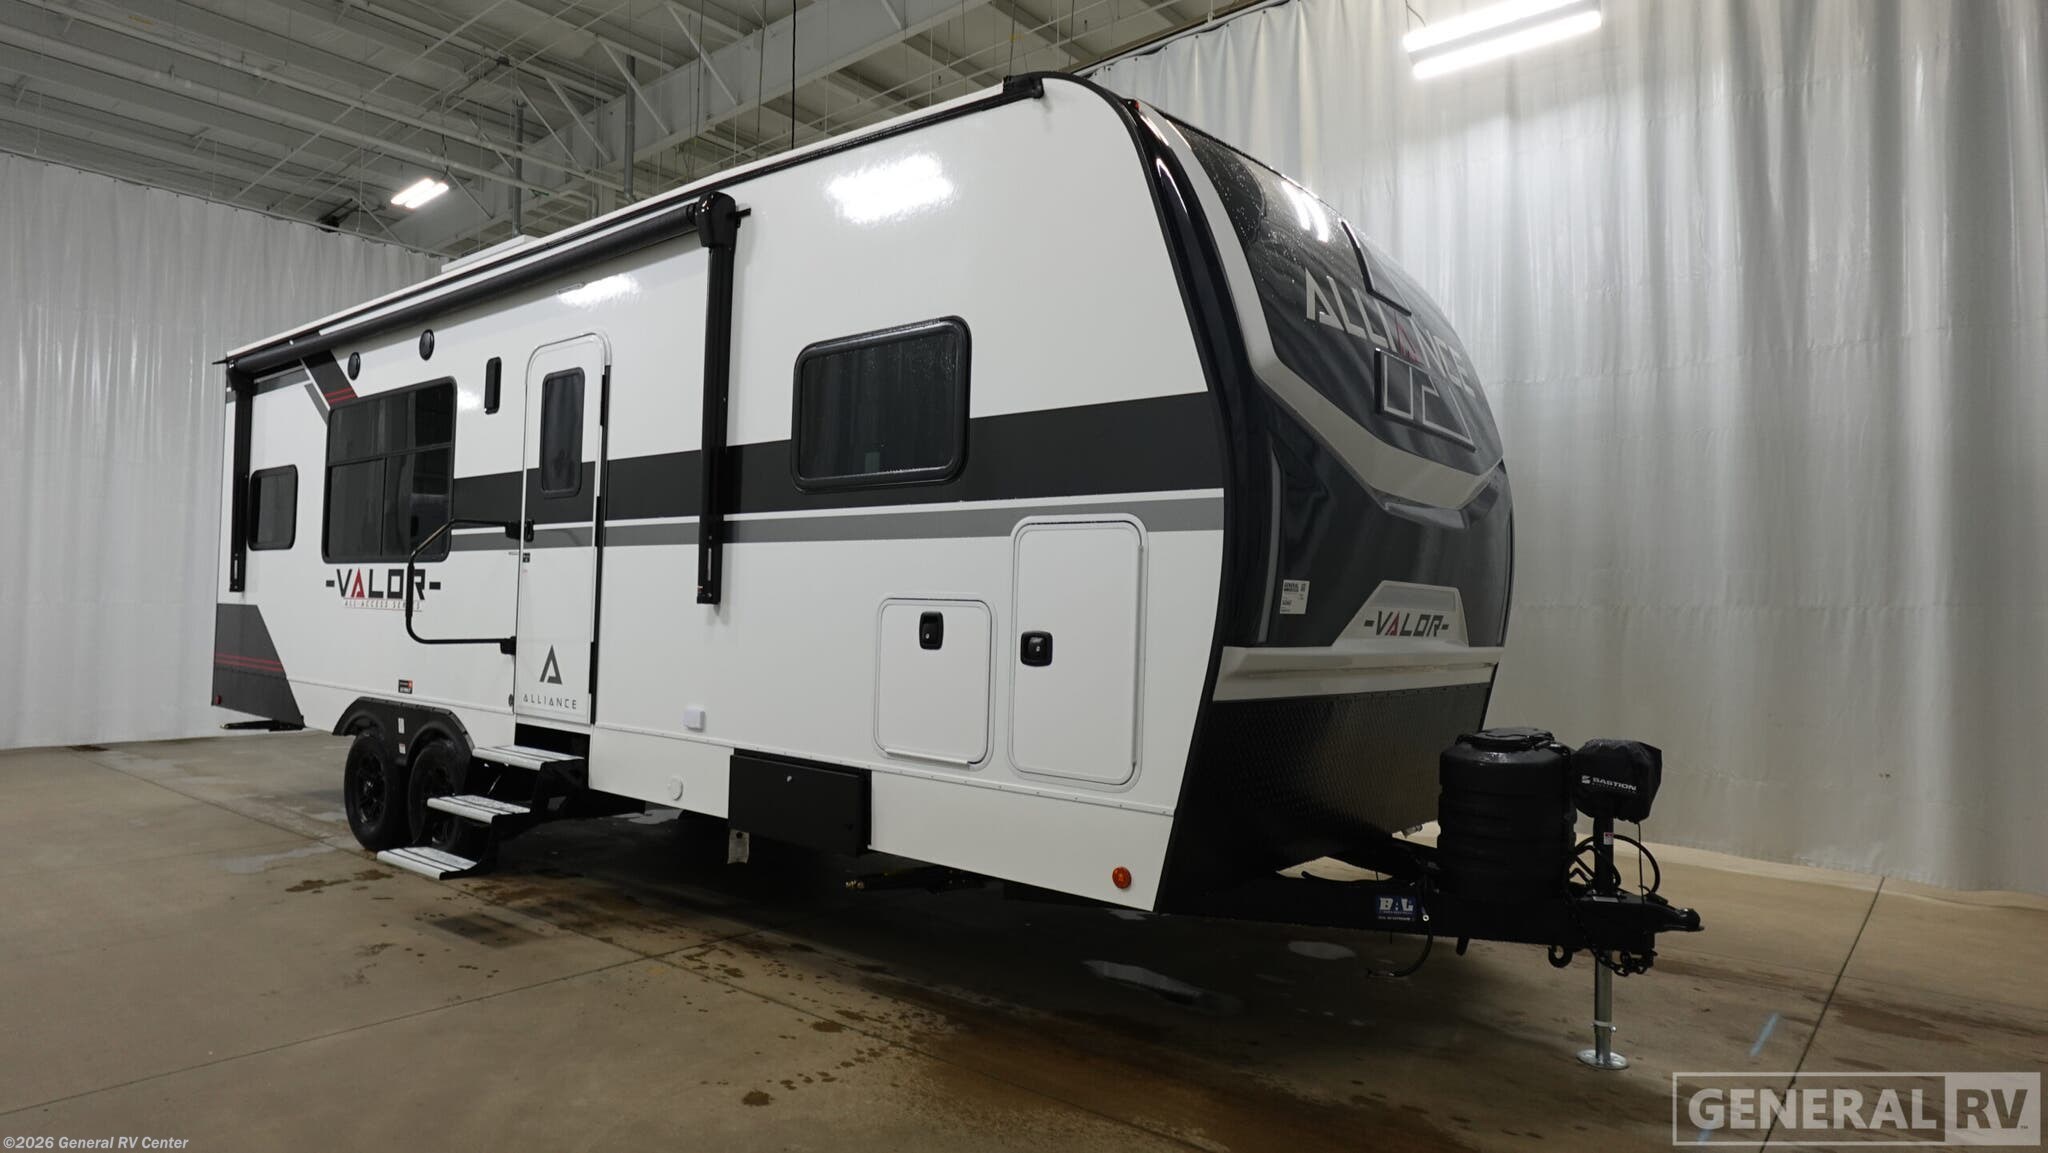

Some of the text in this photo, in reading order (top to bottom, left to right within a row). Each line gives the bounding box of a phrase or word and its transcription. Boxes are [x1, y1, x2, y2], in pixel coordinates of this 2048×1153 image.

[1305, 268, 1475, 398] ALLIANCE
[523, 694, 576, 709] ALLIANCE
[1592, 776, 1637, 791] BASTION
